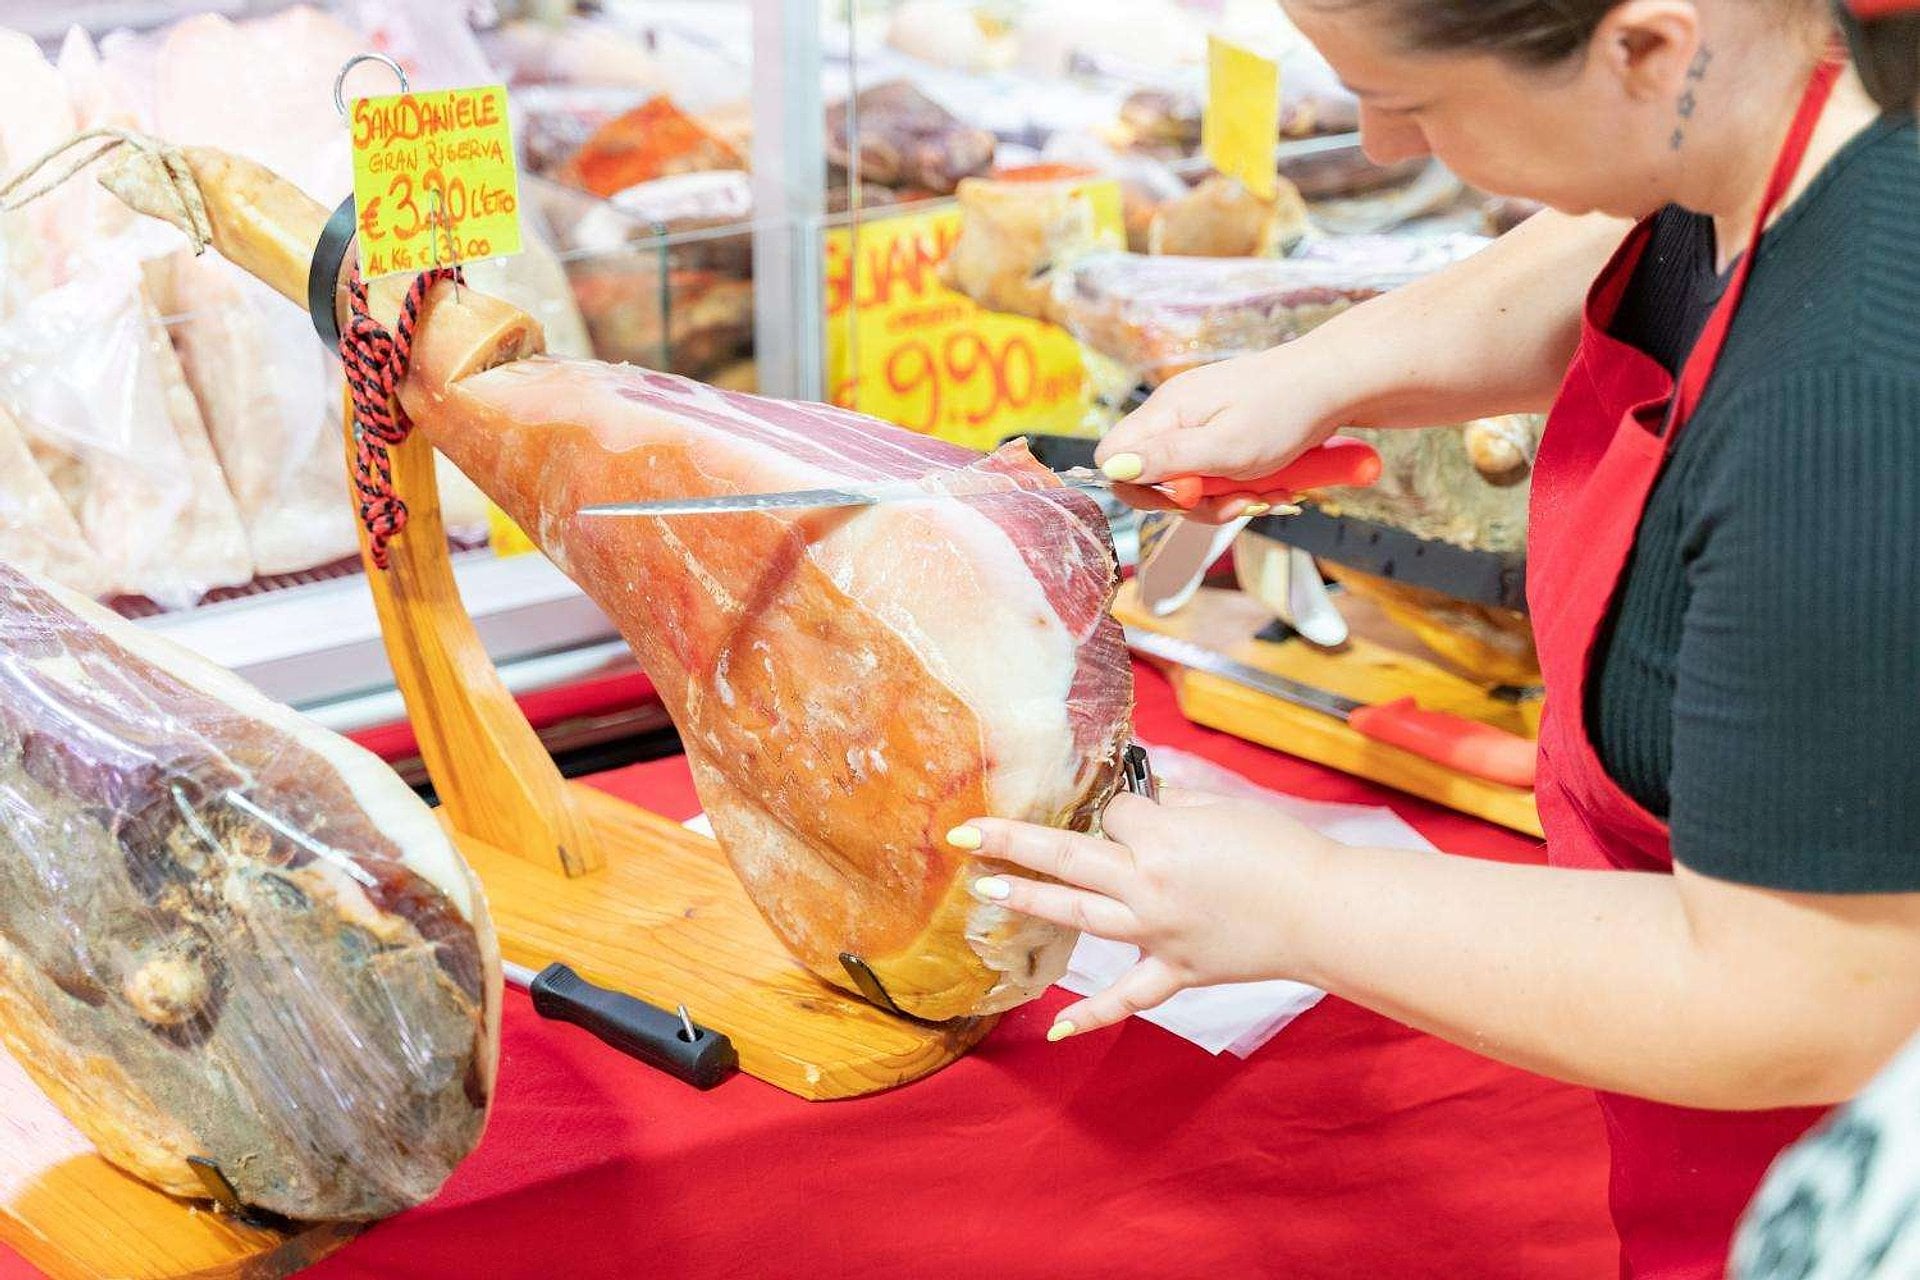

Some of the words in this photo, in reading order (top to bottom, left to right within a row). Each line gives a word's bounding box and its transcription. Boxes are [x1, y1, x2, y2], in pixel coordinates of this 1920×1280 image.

[369, 146, 418, 174] GRAN
[360, 196, 386, 241] €
[369, 254, 388, 277] AL
[391, 246, 412, 270] KG
